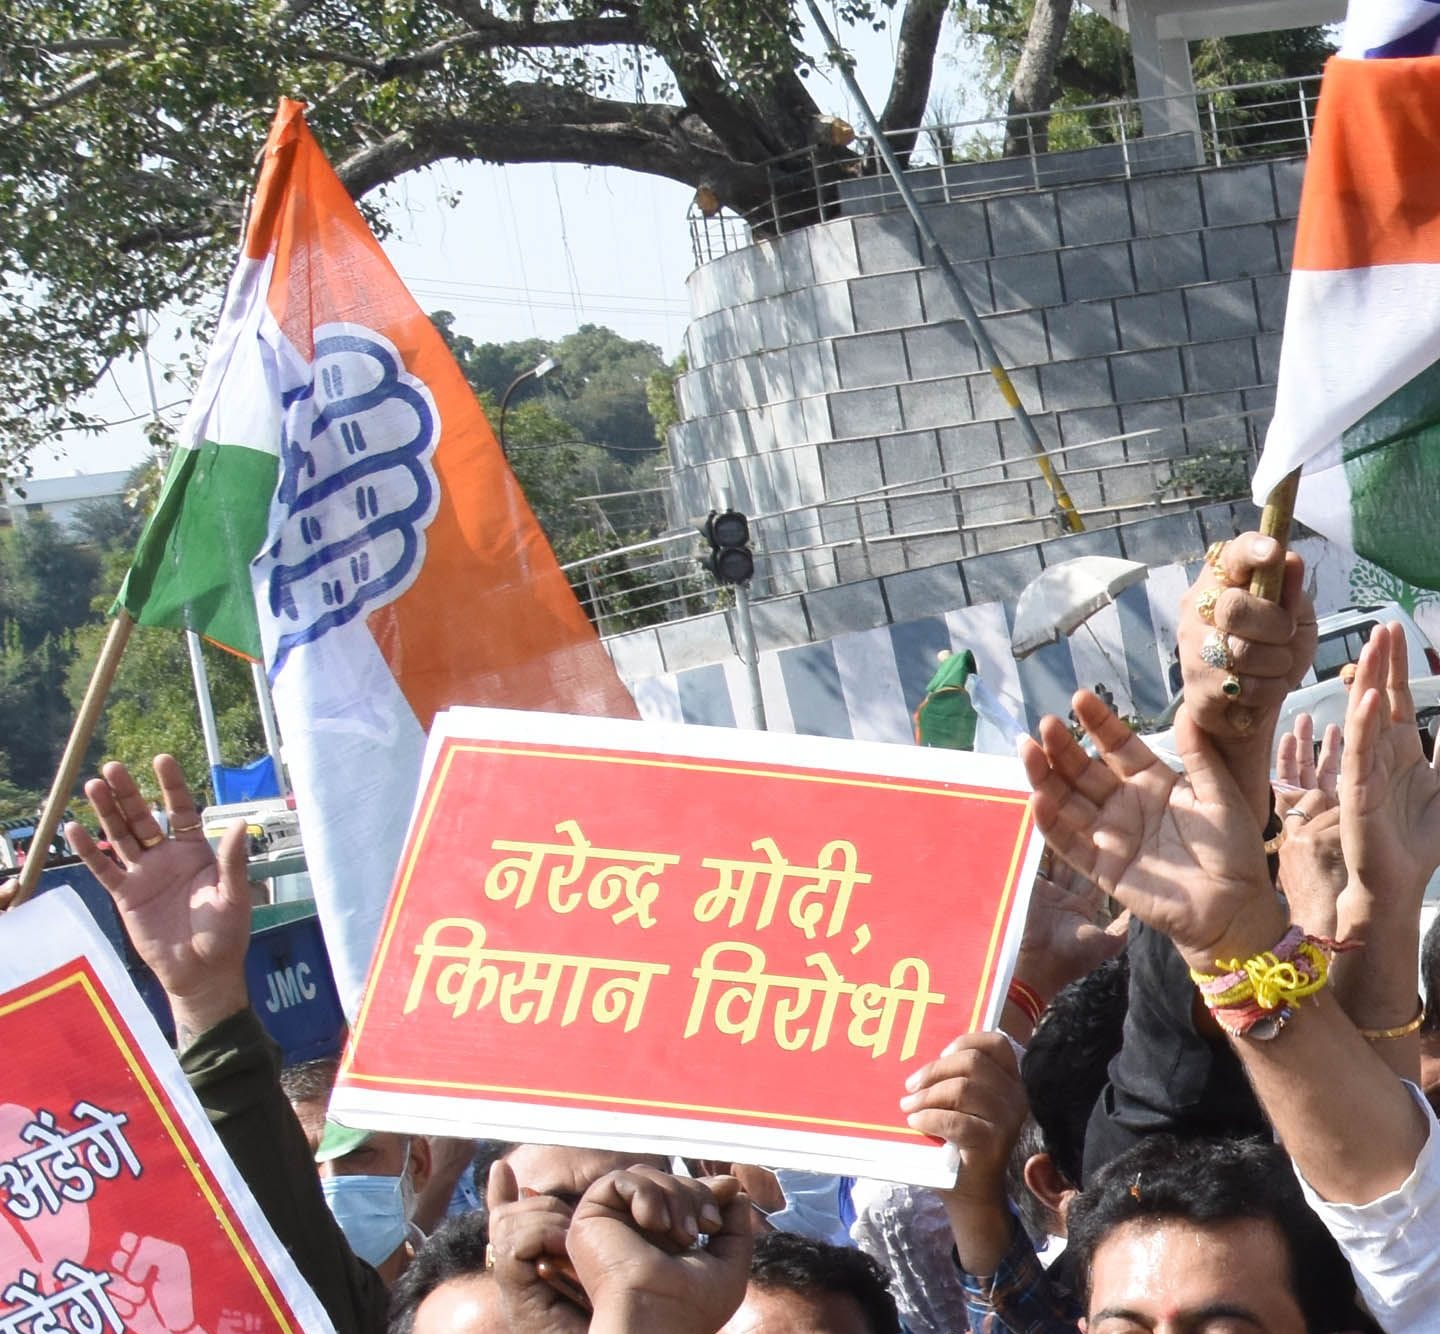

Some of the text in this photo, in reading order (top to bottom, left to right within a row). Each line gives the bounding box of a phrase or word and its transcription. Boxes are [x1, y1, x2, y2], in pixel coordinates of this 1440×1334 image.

[484, 818, 874, 955] नरेन्द्र मोदी,
[264, 961, 317, 1014] JMC
[400, 916, 945, 1063] किसान विरोधी
